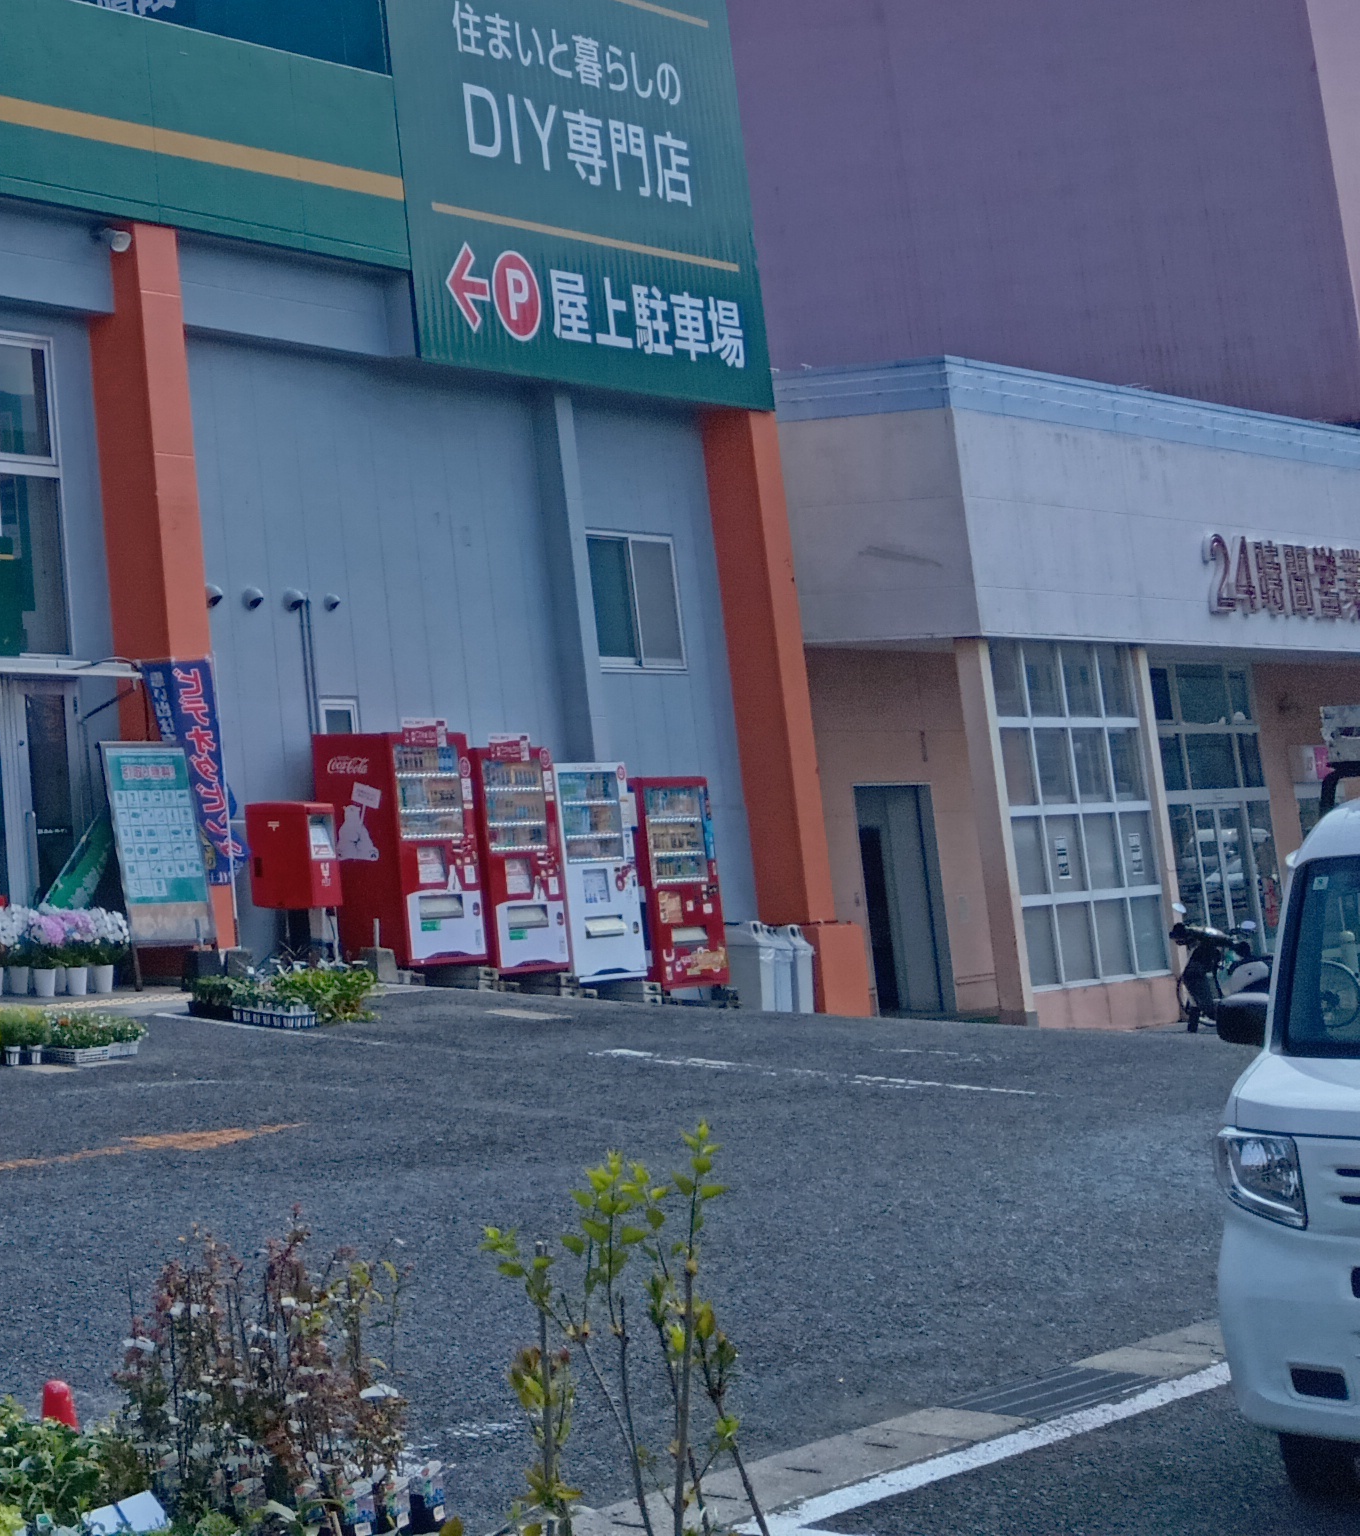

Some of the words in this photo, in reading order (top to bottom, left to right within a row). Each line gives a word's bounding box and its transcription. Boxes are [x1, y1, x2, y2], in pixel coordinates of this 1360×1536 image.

[452, 0, 682, 106] 住まいと暮らしの
[462, 82, 692, 208] DIY専門店
[550, 268, 745, 369] 屋上駐車場
